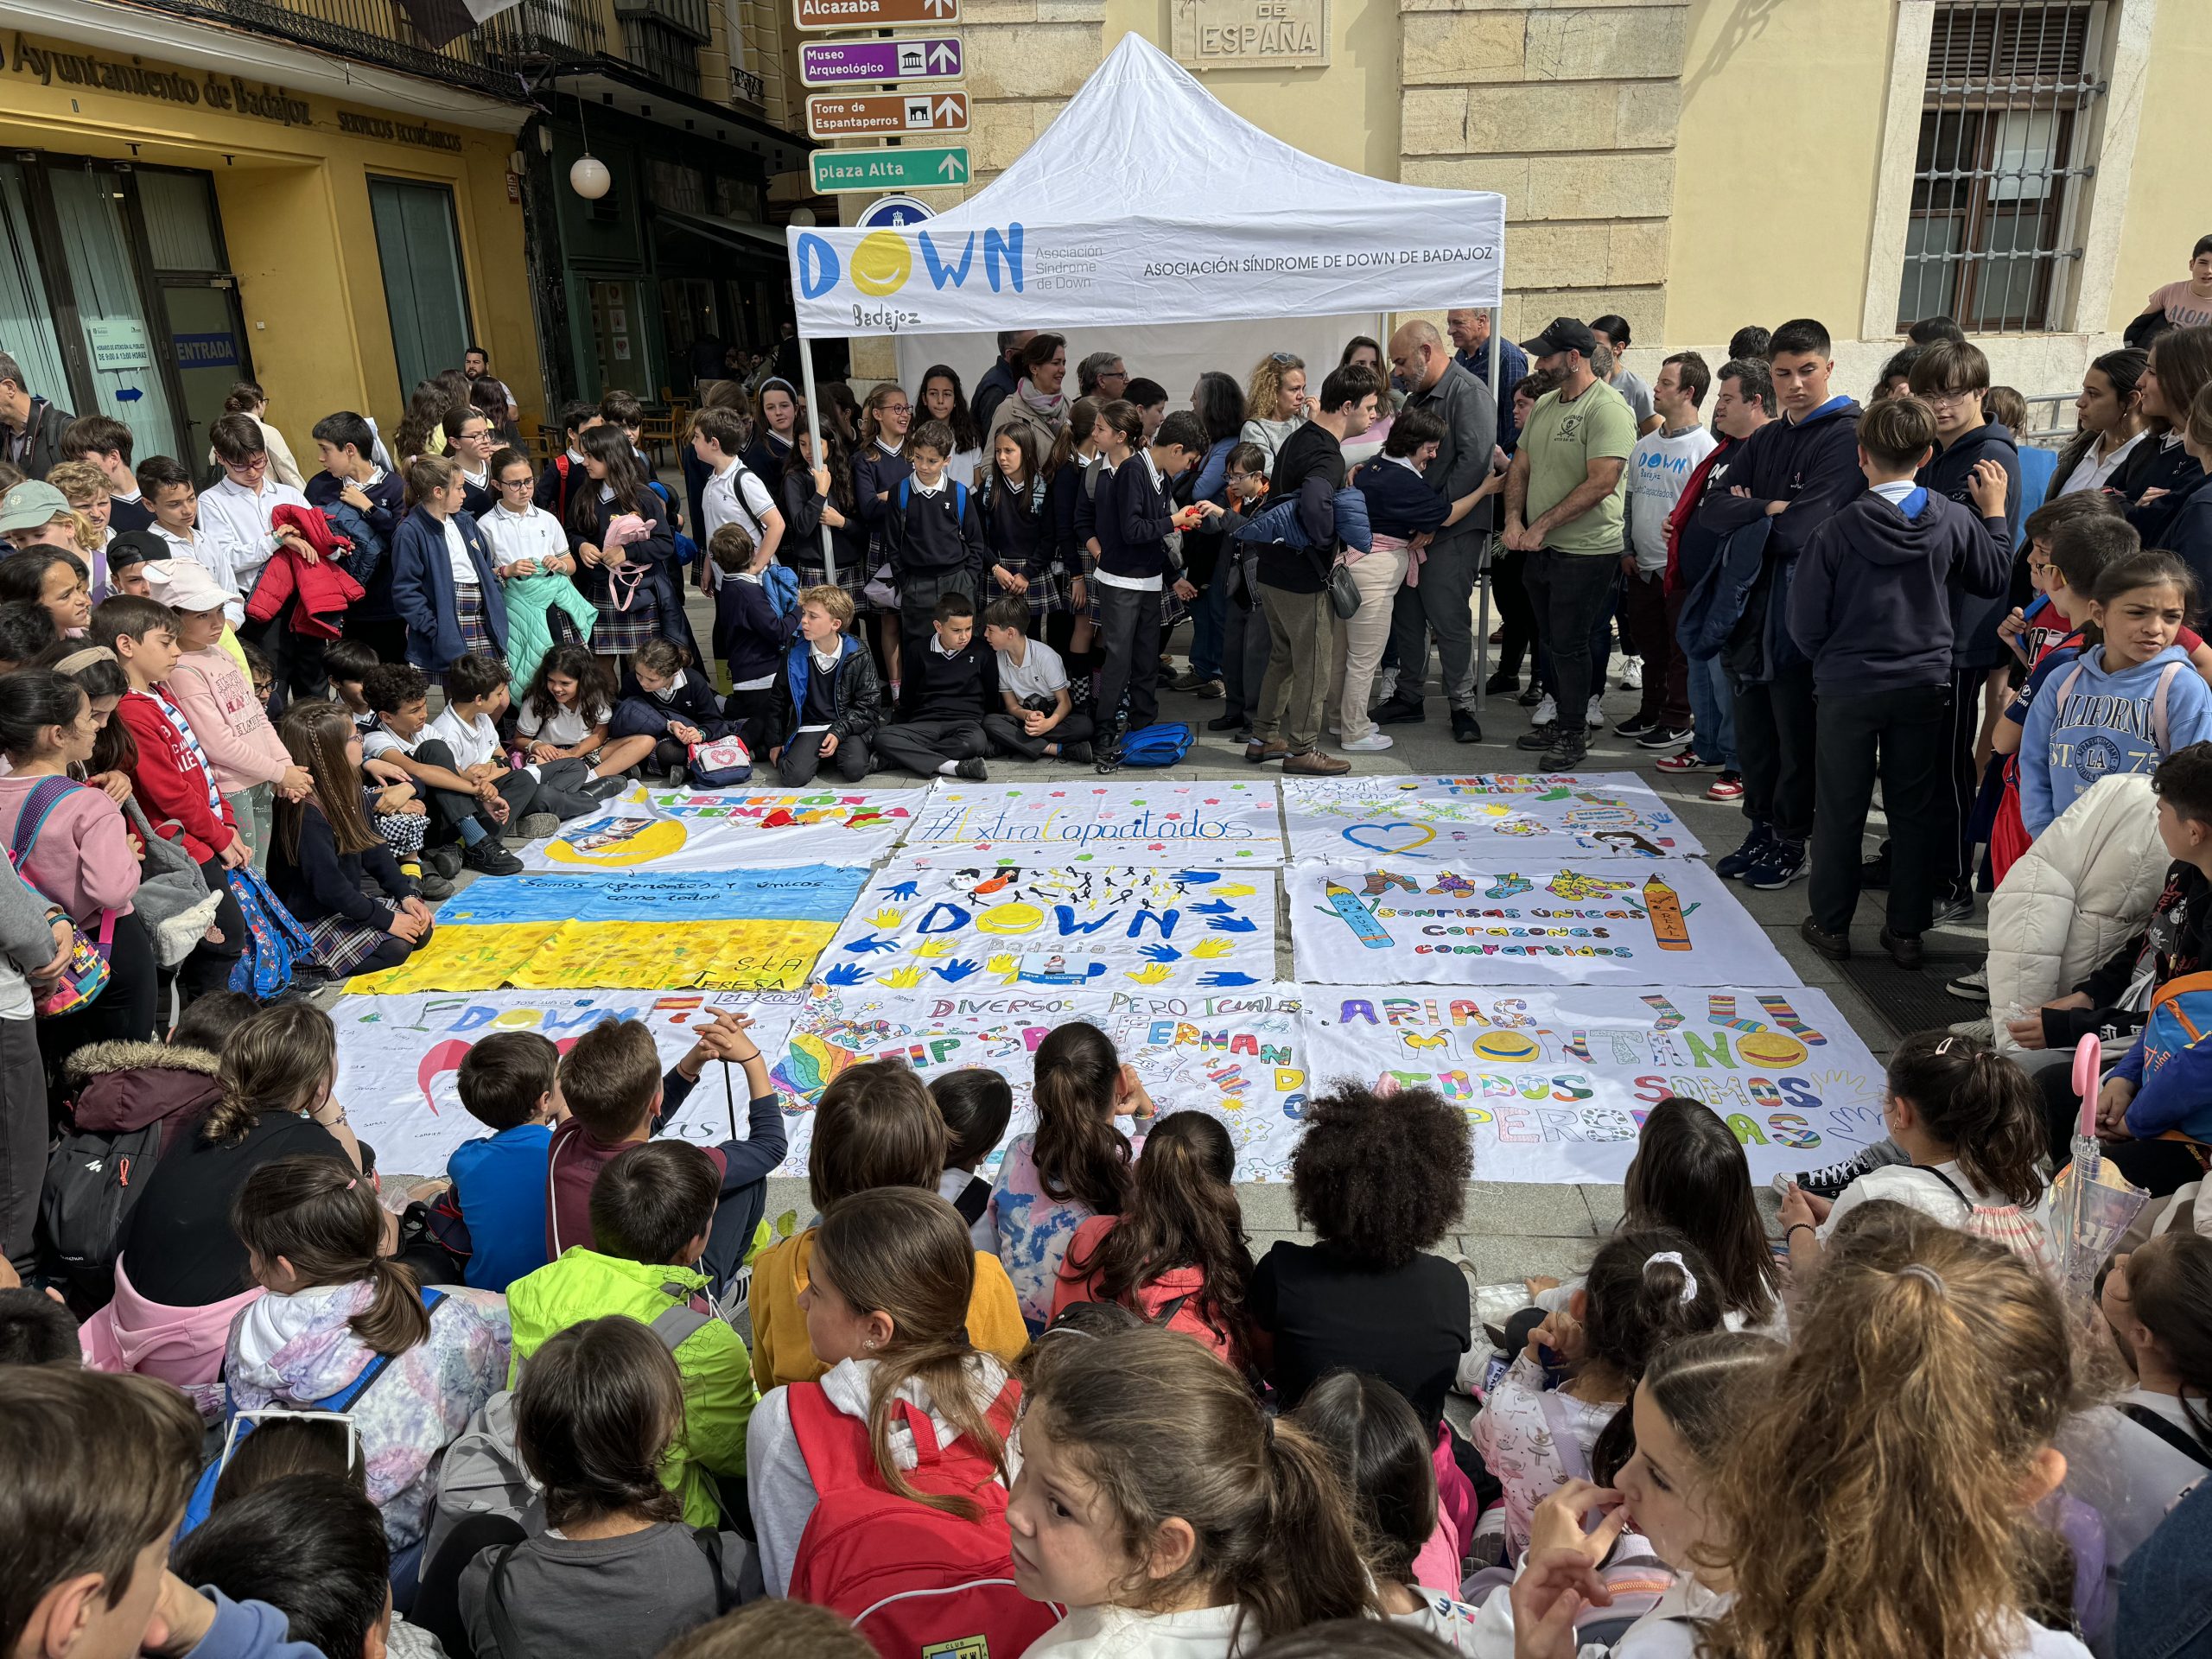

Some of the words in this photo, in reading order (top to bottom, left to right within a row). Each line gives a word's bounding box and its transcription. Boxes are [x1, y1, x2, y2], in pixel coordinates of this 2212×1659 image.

[803, 0, 880, 16] Alcazaba
[1258, 3, 1287, 16] DE
[1201, 16, 1318, 54] ESPAÑA
[807, 50, 844, 60] Museo
[12, 32, 200, 105] Ayuntamiento
[204, 72, 232, 111] de
[232, 76, 313, 127] Badajoz
[809, 62, 884, 76] Arqueológico
[815, 104, 844, 114] Torre
[851, 102, 865, 112] de
[337, 111, 395, 139] SERVICIOS
[816, 116, 899, 129] Espantaperros
[818, 163, 864, 181] plaza
[869, 162, 905, 176] Alta
[797, 222, 1025, 300] DOWN
[1035, 245, 1103, 260] Asociación
[1144, 256, 1239, 276] ASOCIACIÓN
[1243, 254, 1319, 273] SÍNDROME
[1323, 255, 1342, 269] DE
[1346, 252, 1395, 267] DOWN
[1400, 250, 1418, 264] DE
[1422, 246, 1492, 263] BADAJOZ
[1035, 262, 1096, 275] Síndrome
[1037, 278, 1052, 290] de
[1056, 276, 1091, 289] Down
[853, 304, 921, 332] Badajoz
[2169, 303, 2212, 326] ALOH
[175, 340, 234, 359] ENTRADA
[1638, 452, 1687, 474] DOWN
[2050, 694, 2161, 751] ALIFORNI
[2086, 749, 2107, 769] LA
[916, 902, 1181, 939] DOWN
[1108, 992, 1188, 1016] PERO
[1338, 998, 1537, 1029] ARIAS
[1395, 1027, 1808, 1070] MONTANO
[1633, 1075, 1823, 1108] SOMOS
[945, 1641, 964, 1649] CLUB
